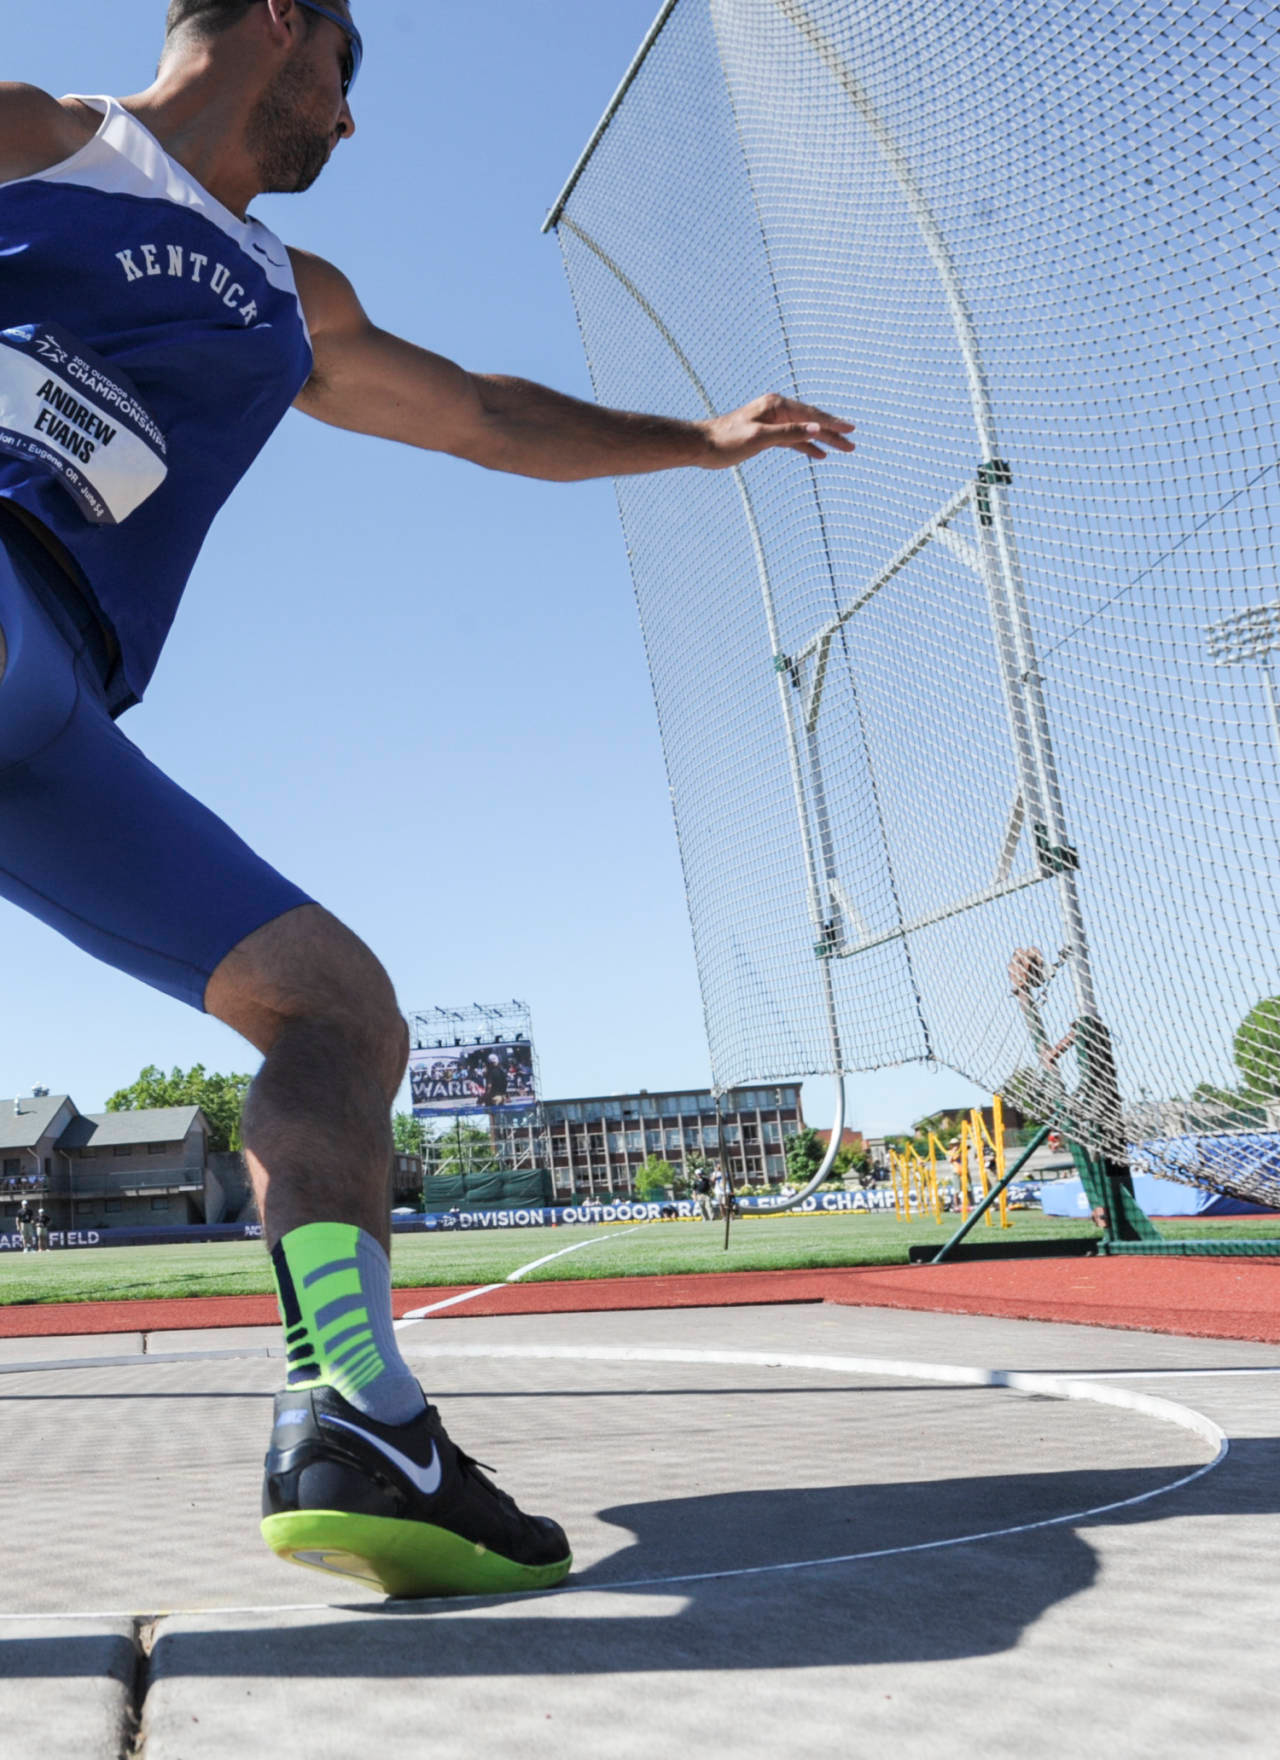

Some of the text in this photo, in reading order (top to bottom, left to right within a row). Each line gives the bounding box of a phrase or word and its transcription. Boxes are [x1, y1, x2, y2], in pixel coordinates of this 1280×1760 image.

[115, 244, 258, 326] KENTUCK
[34, 407, 96, 465] EVANS
[36, 378, 117, 447] ANDREW
[67, 362, 167, 455] CHAMPIONSHIPS
[65, 468, 79, 484] OR
[48, 1230, 100, 1246] FIELD
[459, 1208, 544, 1228] DIVISION
[551, 1208, 557, 1224] I
[562, 1202, 661, 1223] OUTDOOR
